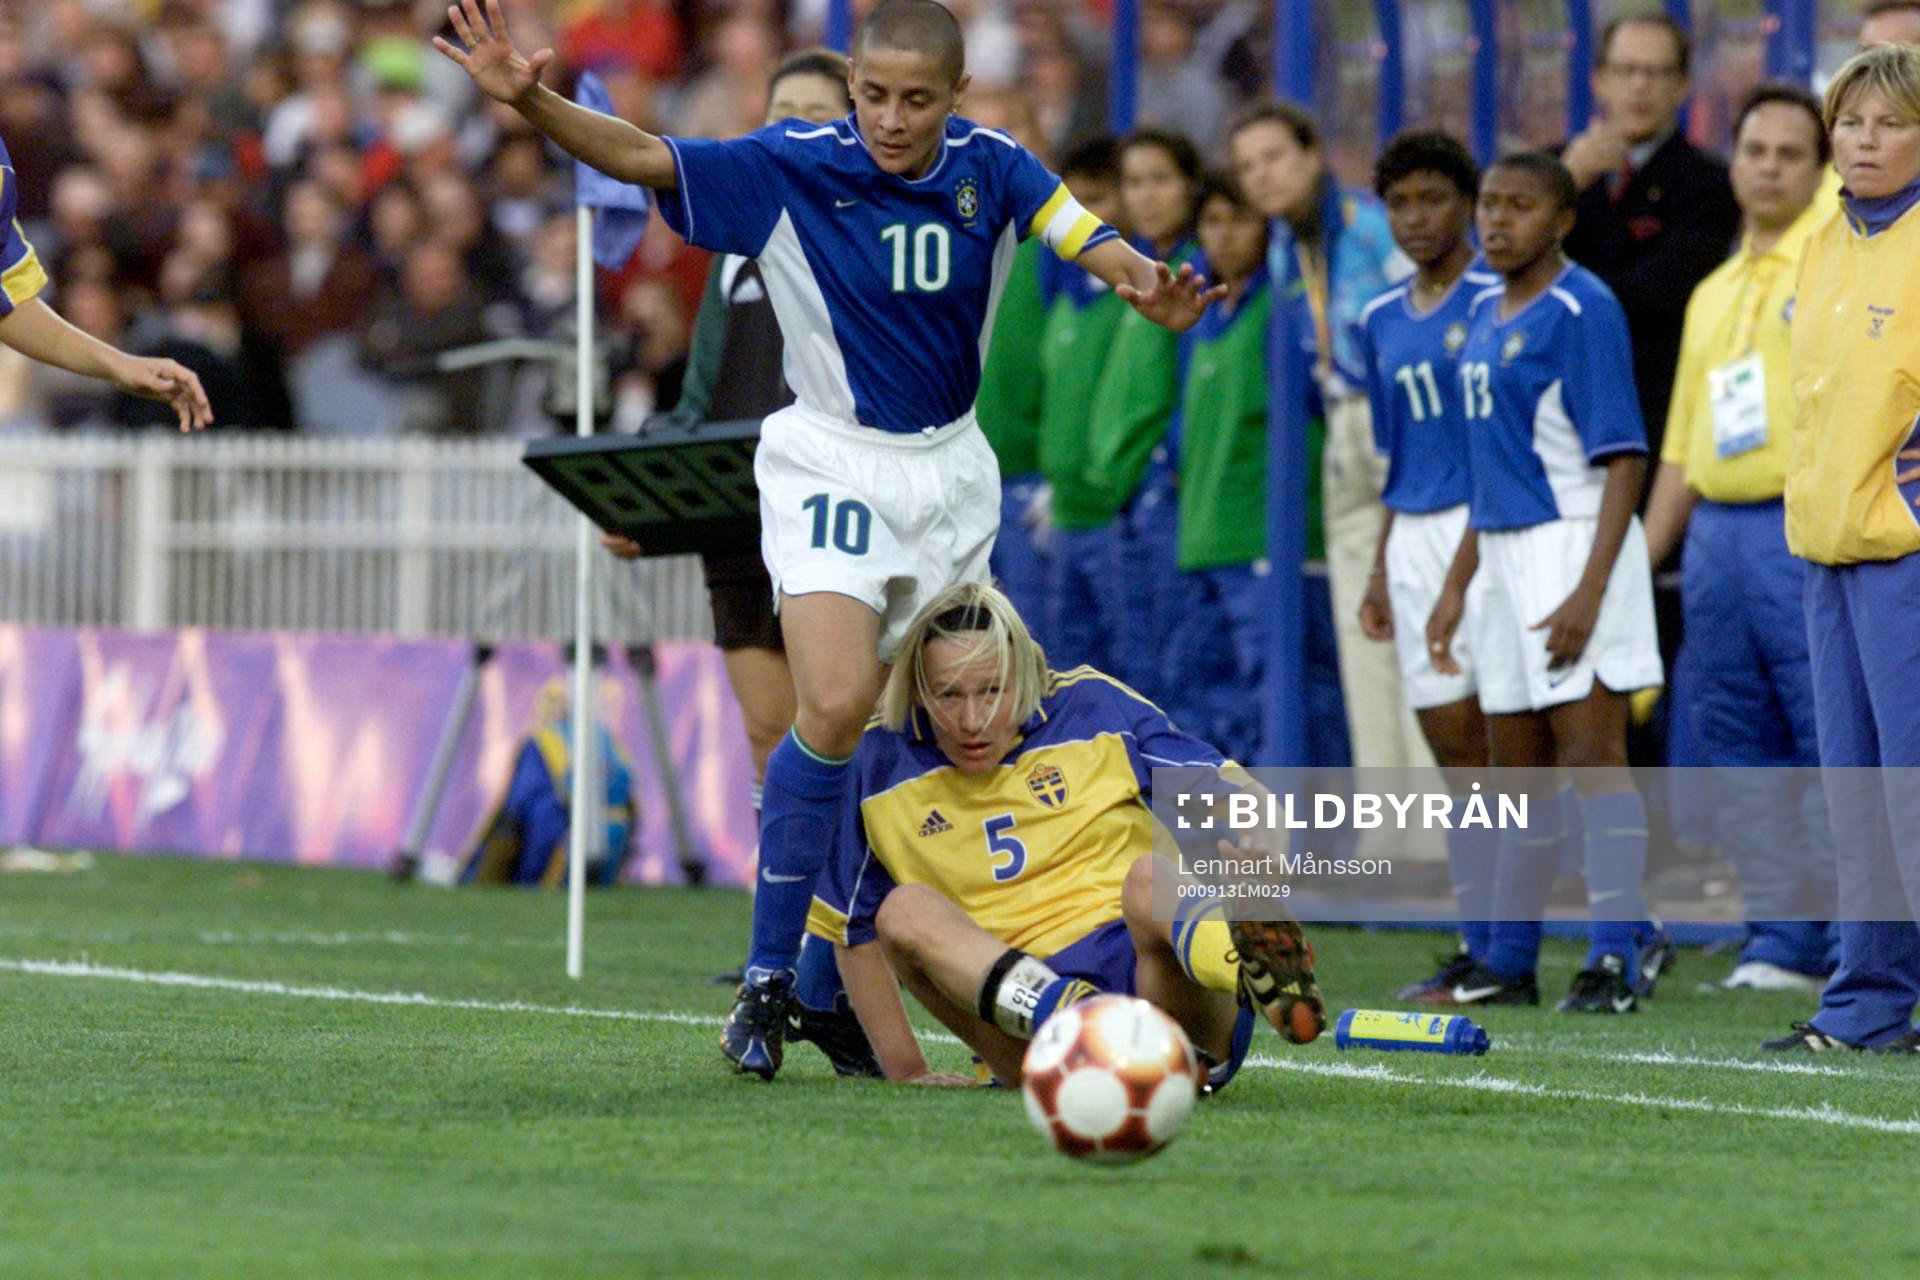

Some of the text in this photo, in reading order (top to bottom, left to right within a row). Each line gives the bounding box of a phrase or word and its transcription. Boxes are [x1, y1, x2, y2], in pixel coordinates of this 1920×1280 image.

[881, 223, 950, 293] 10
[1395, 360, 1443, 422] 11
[1460, 361, 1494, 420] 13
[802, 493, 872, 556] 10
[983, 812, 1028, 883] 5
